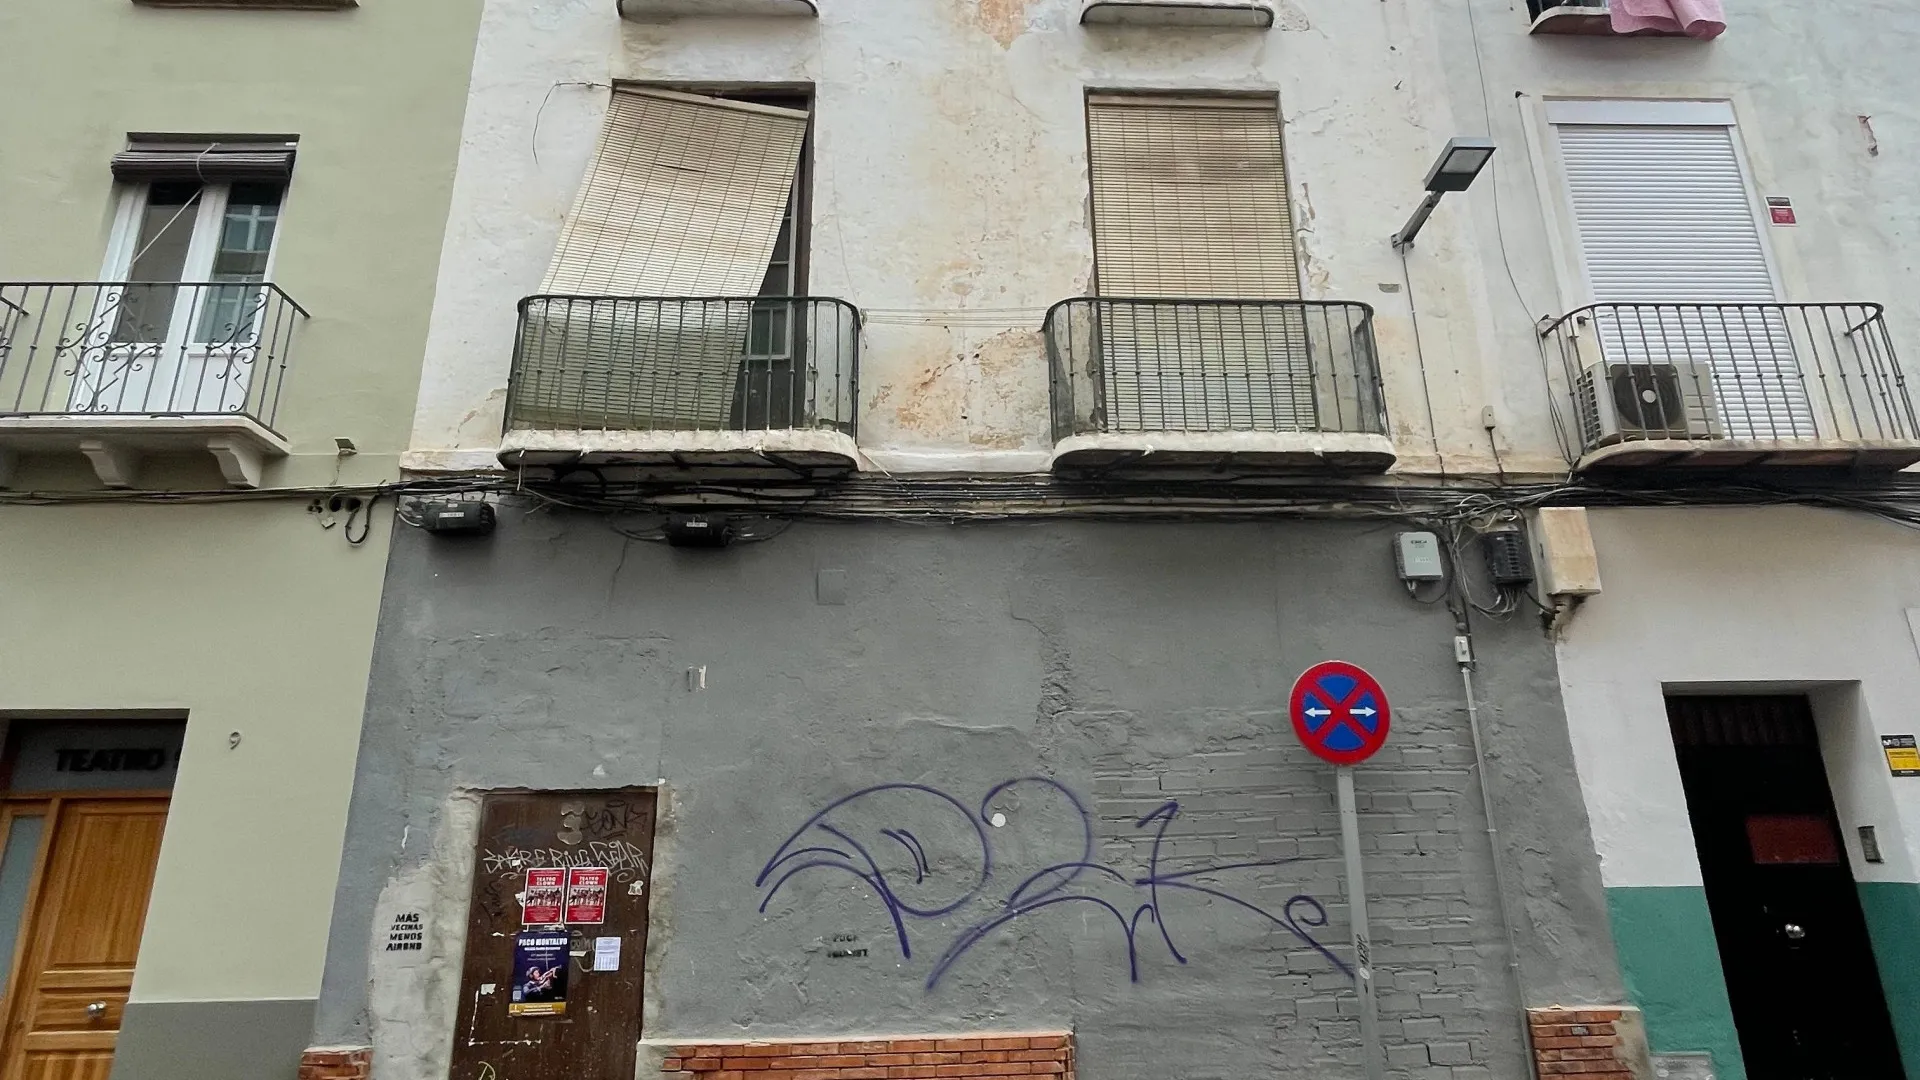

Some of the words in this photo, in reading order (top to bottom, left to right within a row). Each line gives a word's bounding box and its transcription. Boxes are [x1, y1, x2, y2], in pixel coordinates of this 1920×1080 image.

[229, 731, 241, 750] 9
[389, 932, 423, 941] MENOS
[385, 942, 422, 952] AIRBNB
[518, 938, 535, 947] PACO
[535, 937, 568, 946] MONTALVO
